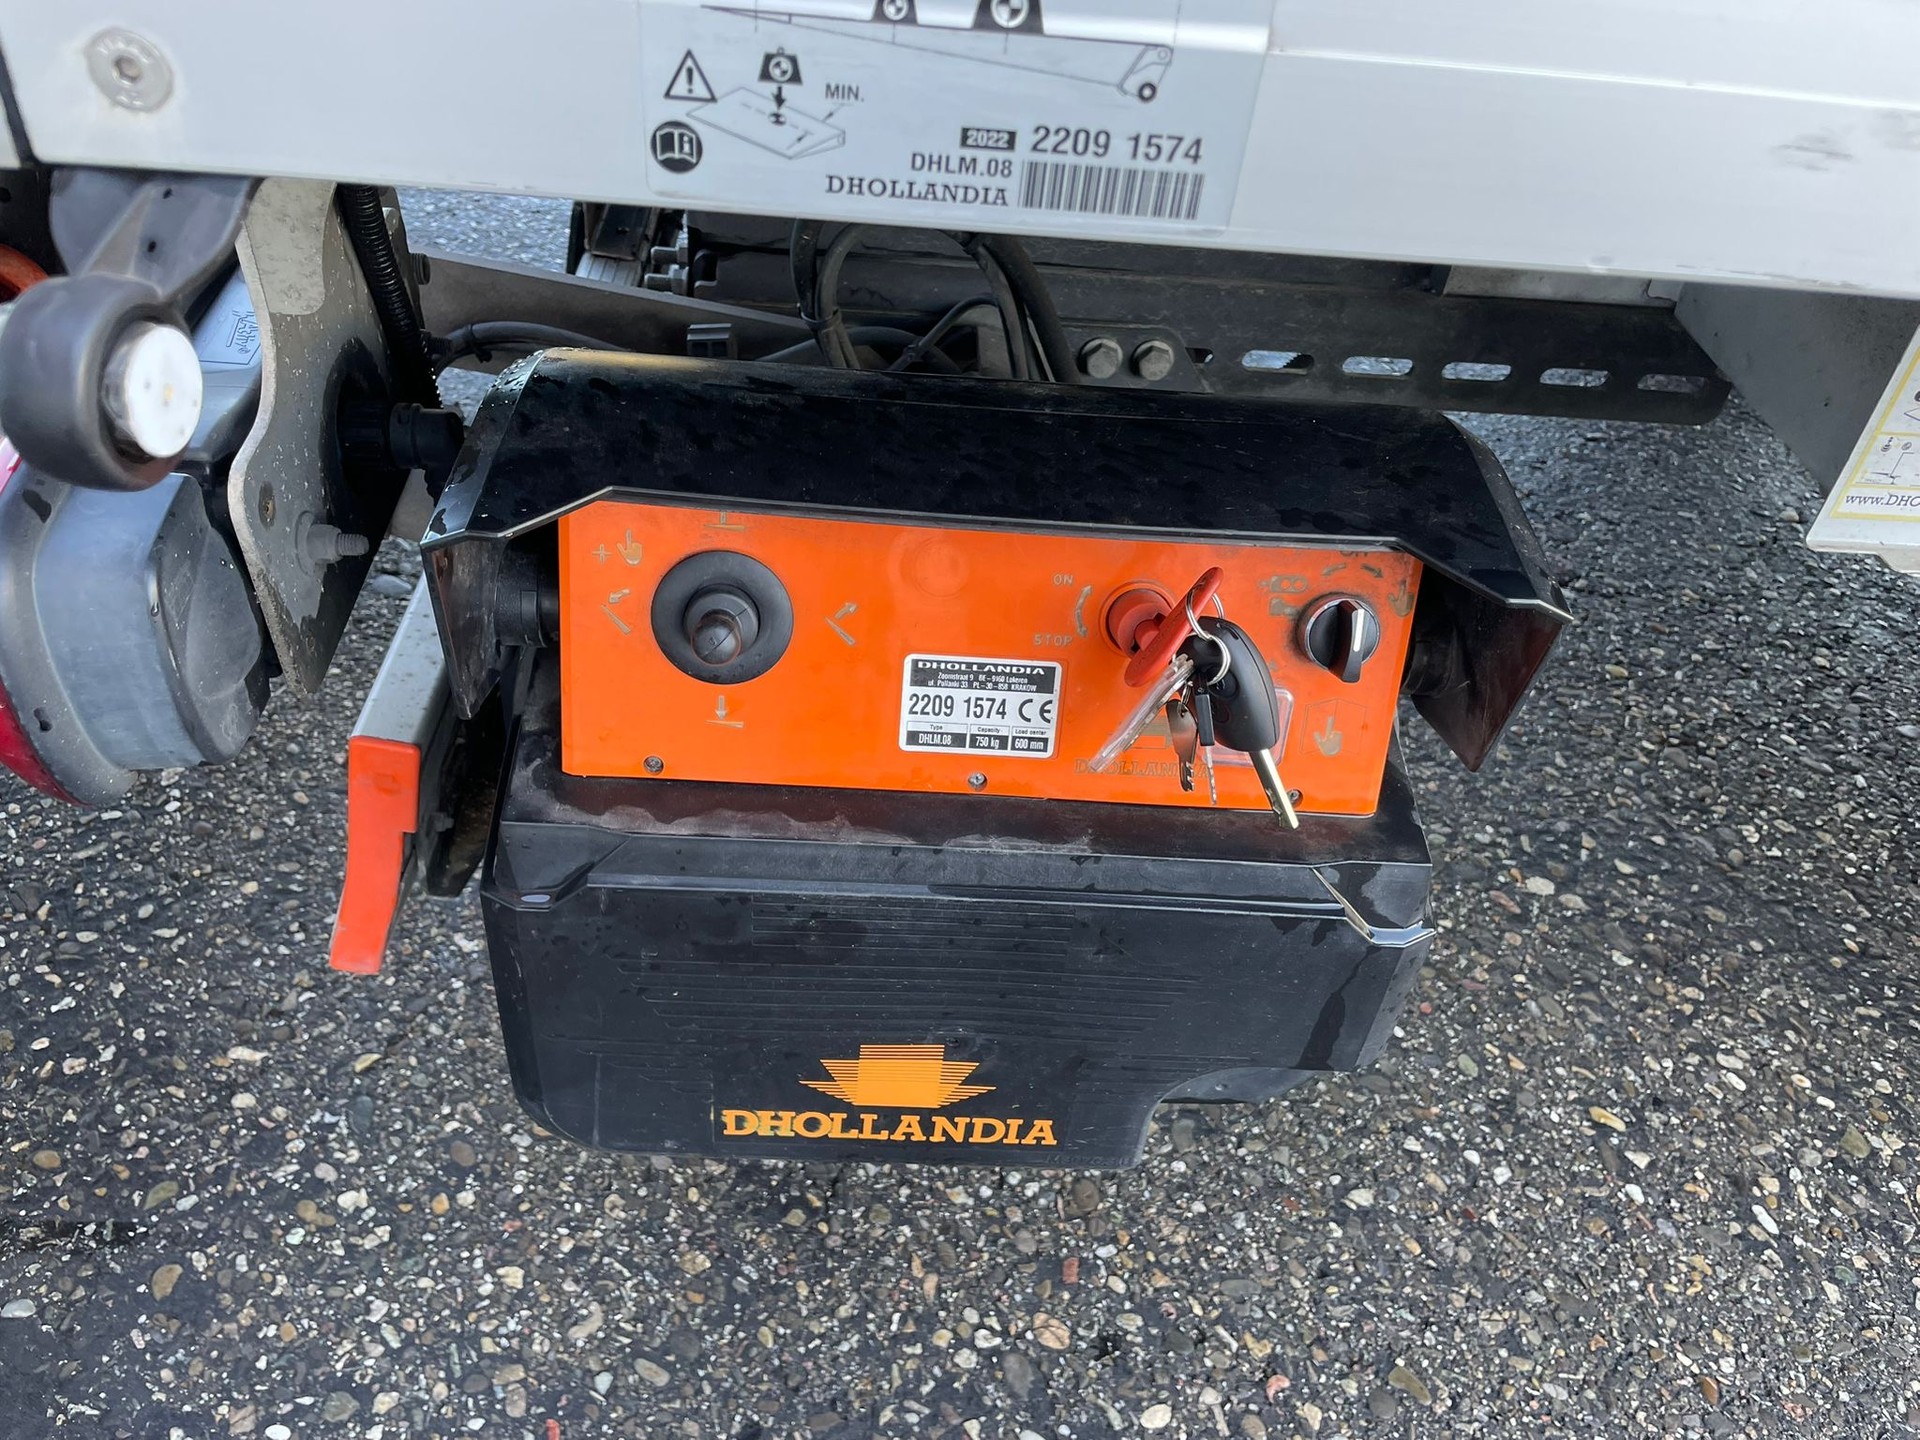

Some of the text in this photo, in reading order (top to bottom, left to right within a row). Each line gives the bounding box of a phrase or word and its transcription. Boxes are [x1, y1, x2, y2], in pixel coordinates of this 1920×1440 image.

[825, 83, 864, 102] MIN.
[966, 125, 1203, 165] 2022 2209 1574
[910, 152, 1013, 178] DHLM.08
[825, 174, 1009, 206] DHOLLANDIA
[1053, 573, 1074, 586] ON
[1034, 633, 1073, 648] STOP
[917, 660, 1045, 675] DHOLLANDIA
[908, 693, 955, 718] 2209
[963, 696, 1007, 720] 1574
[930, 723, 943, 731] Type
[977, 726, 1000, 734] Capacity
[918, 733, 952, 746] DHLM.08
[975, 736, 1000, 749] 750 kg
[1014, 738, 1044, 750] 600 mm
[723, 1109, 1057, 1146] DHOLLANDIA
